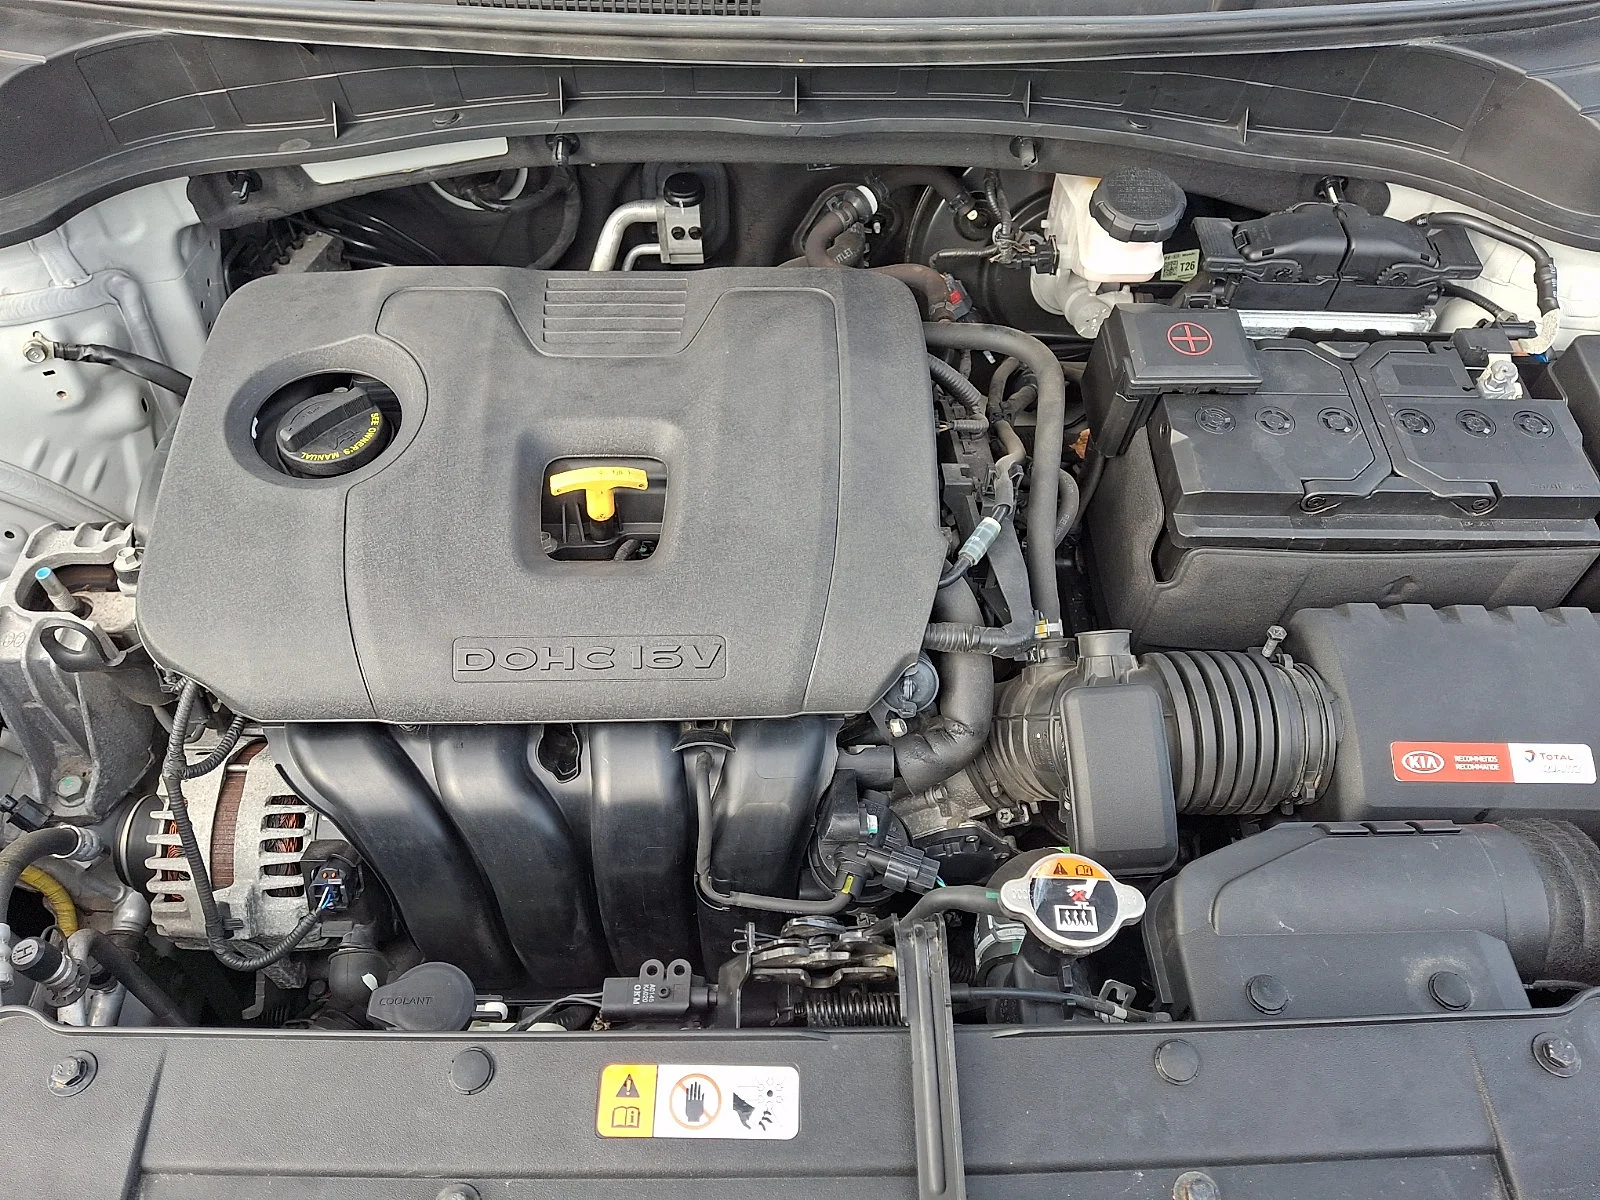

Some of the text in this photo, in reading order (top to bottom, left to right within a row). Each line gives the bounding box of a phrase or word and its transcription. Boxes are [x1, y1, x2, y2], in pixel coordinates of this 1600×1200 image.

[1180, 260, 1196, 272] T26
[301, 412, 381, 461] SEE OWNER'S MANUAL
[456, 644, 723, 672] DOHC 16V
[1408, 754, 1439, 770] KIA
[379, 996, 433, 1006] COOLANT
[632, 984, 642, 1005] OKM
